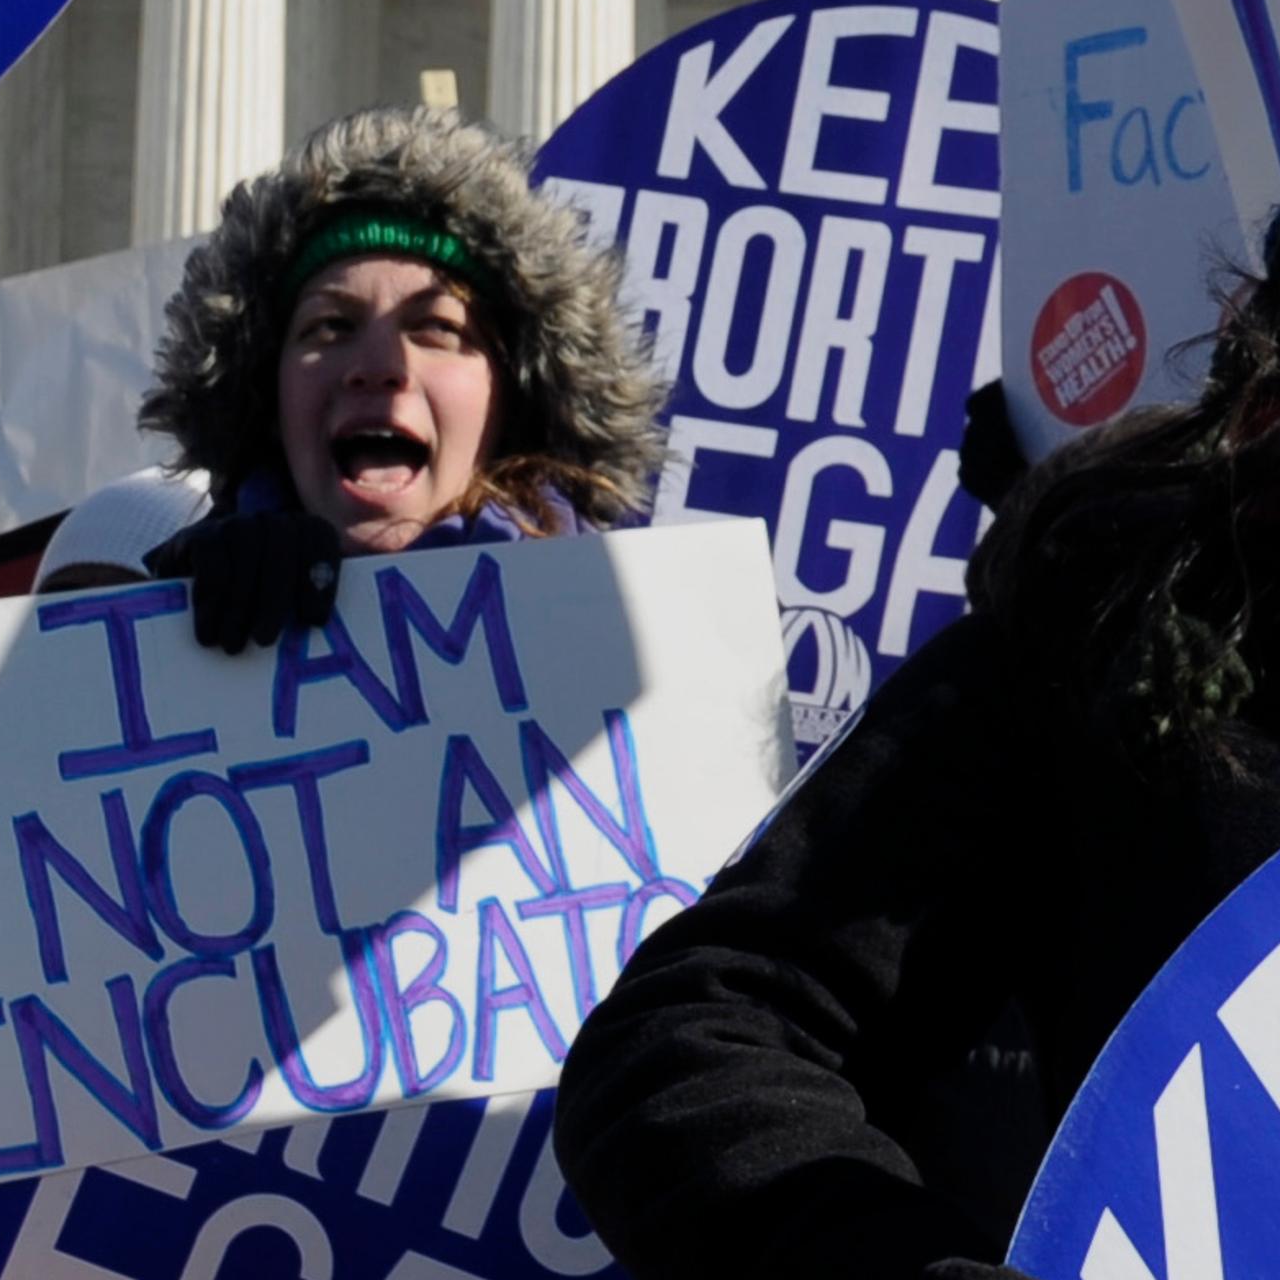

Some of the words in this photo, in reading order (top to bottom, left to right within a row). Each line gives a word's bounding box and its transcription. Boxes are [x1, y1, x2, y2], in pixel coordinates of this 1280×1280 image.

[37, 581, 218, 782] I
[271, 552, 530, 738] AM
[11, 738, 370, 985] NOT
[436, 708, 661, 913] AN
